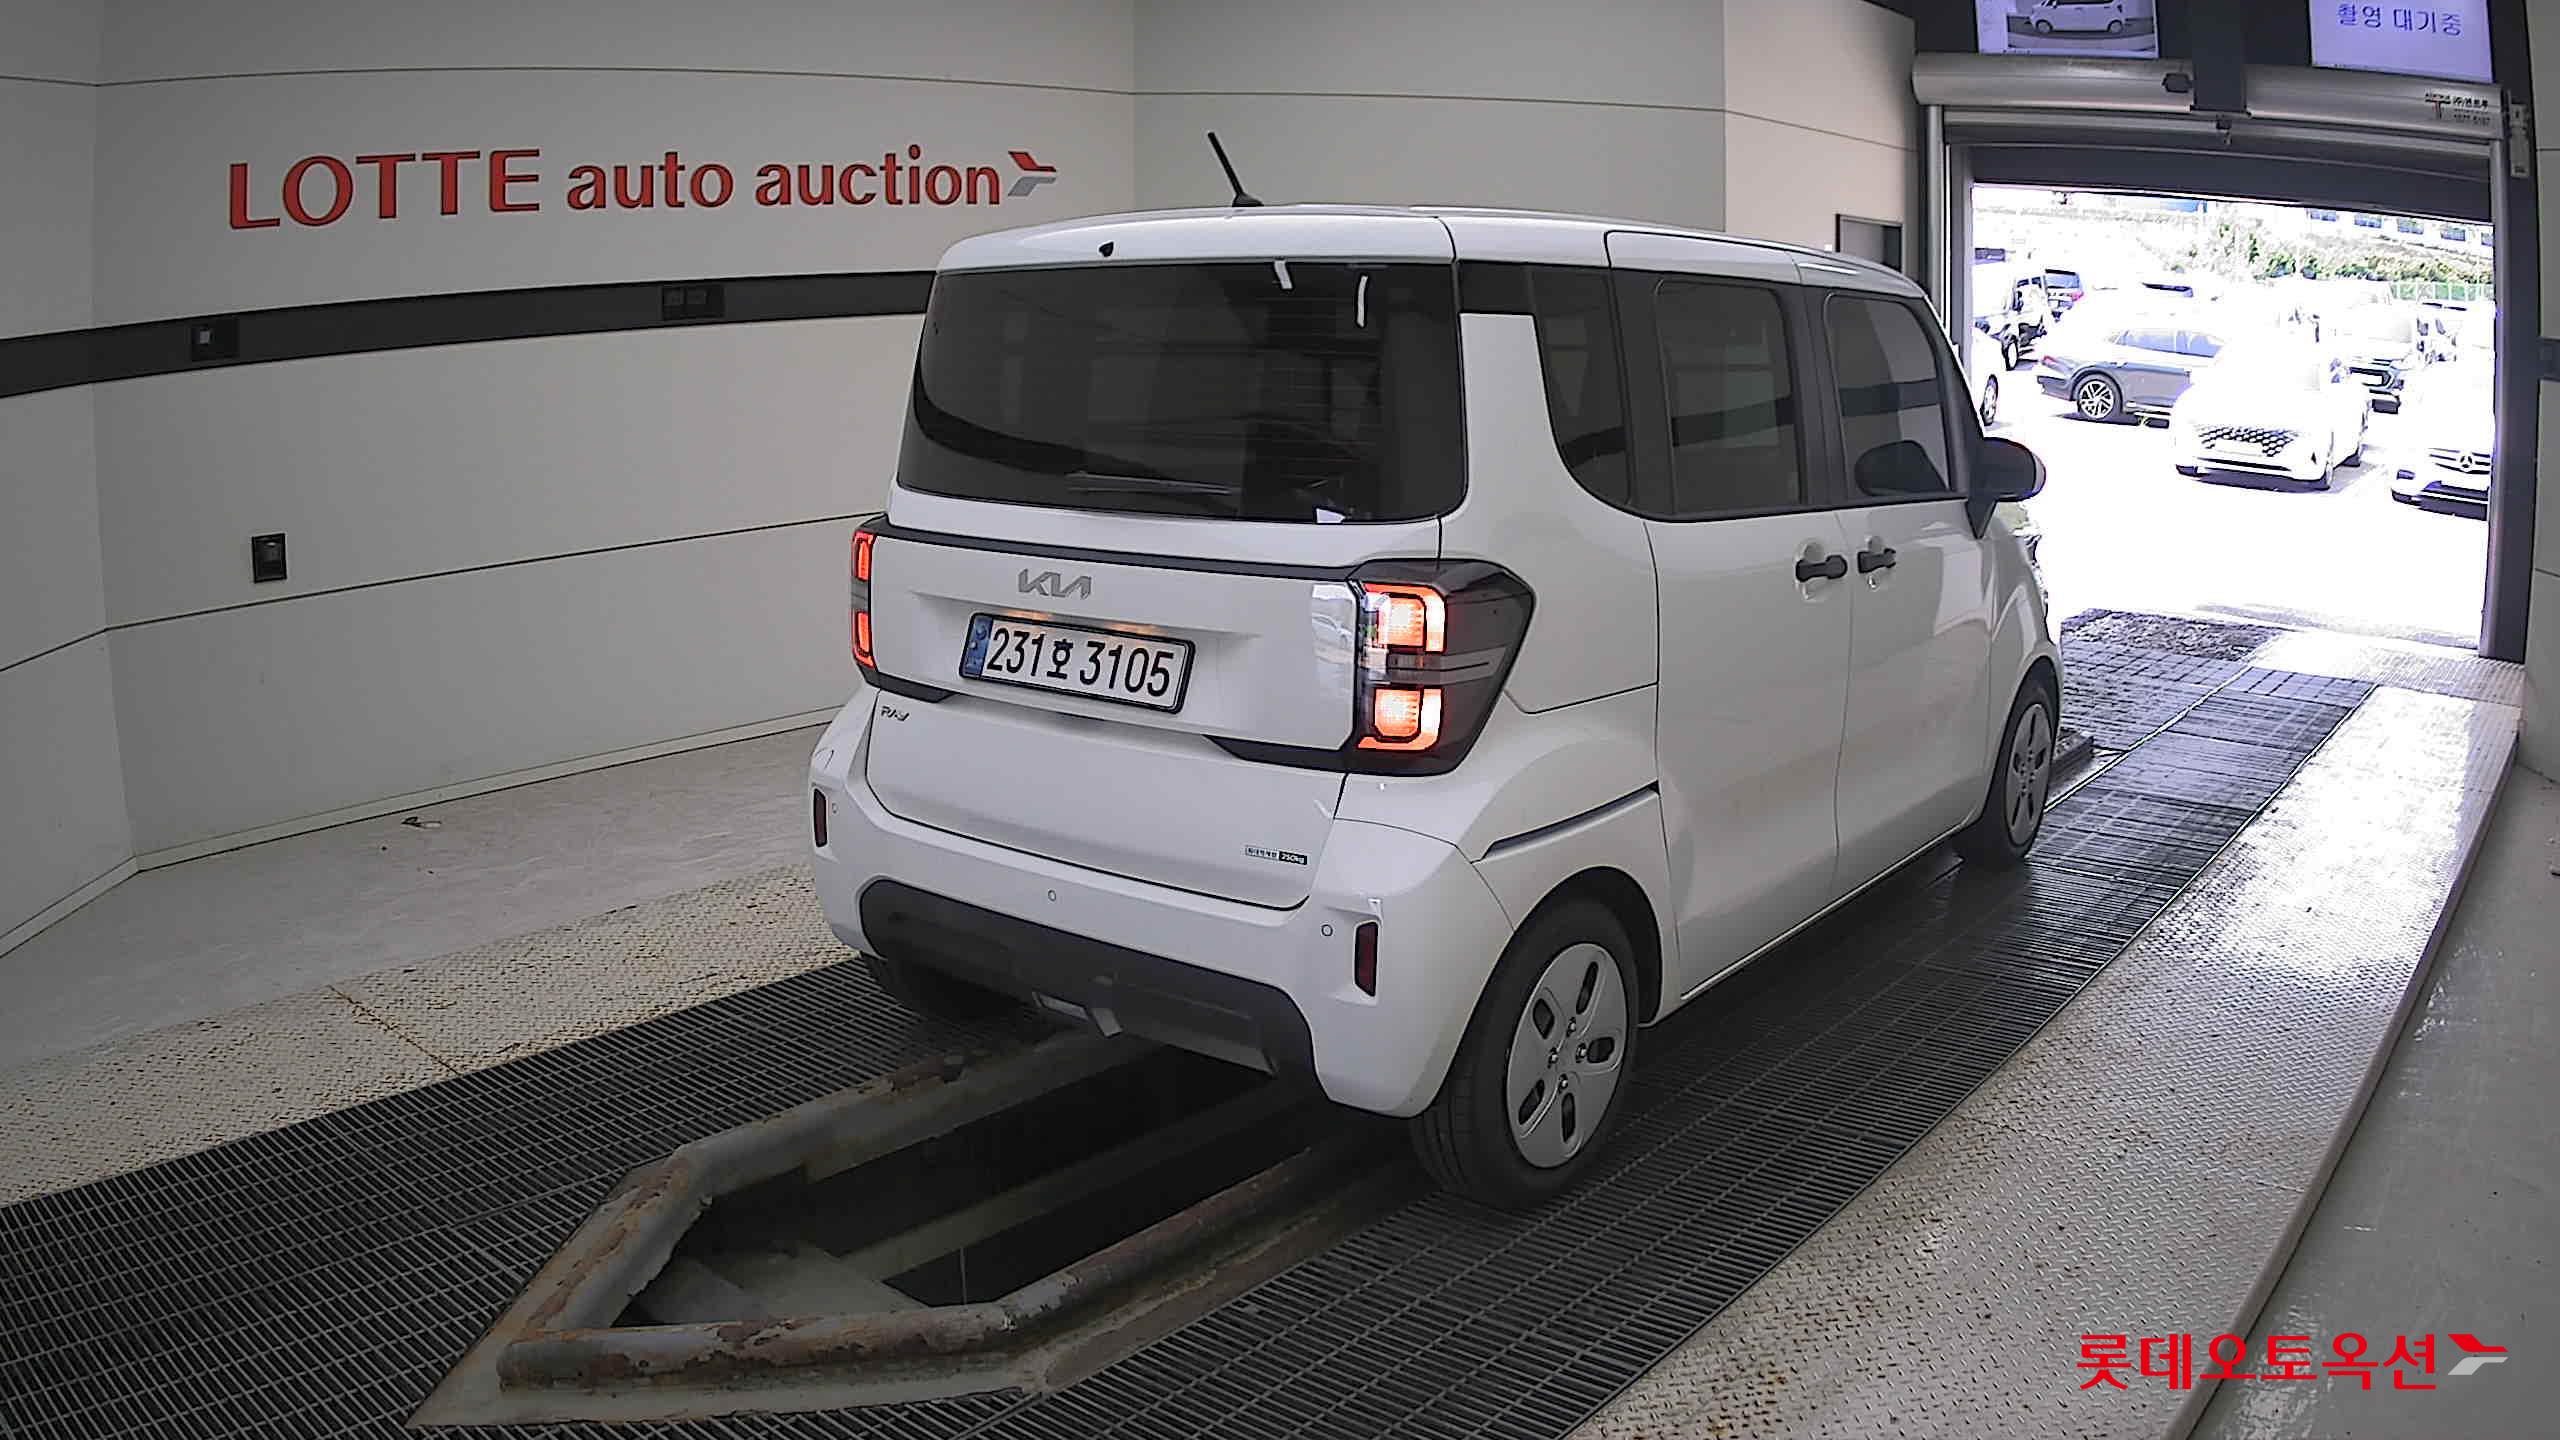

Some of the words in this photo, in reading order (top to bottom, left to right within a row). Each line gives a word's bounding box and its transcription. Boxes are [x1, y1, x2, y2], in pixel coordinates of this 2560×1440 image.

[2338, 3, 2382, 29] 촬영
[2393, 8, 2462, 36] 대기중
[229, 148, 541, 231] LOTTE
[566, 150, 734, 209] auto
[755, 144, 1002, 207] auction
[1018, 568, 1092, 600] KIA
[986, 628, 1074, 680] 231호
[1079, 640, 1175, 697] 3105
